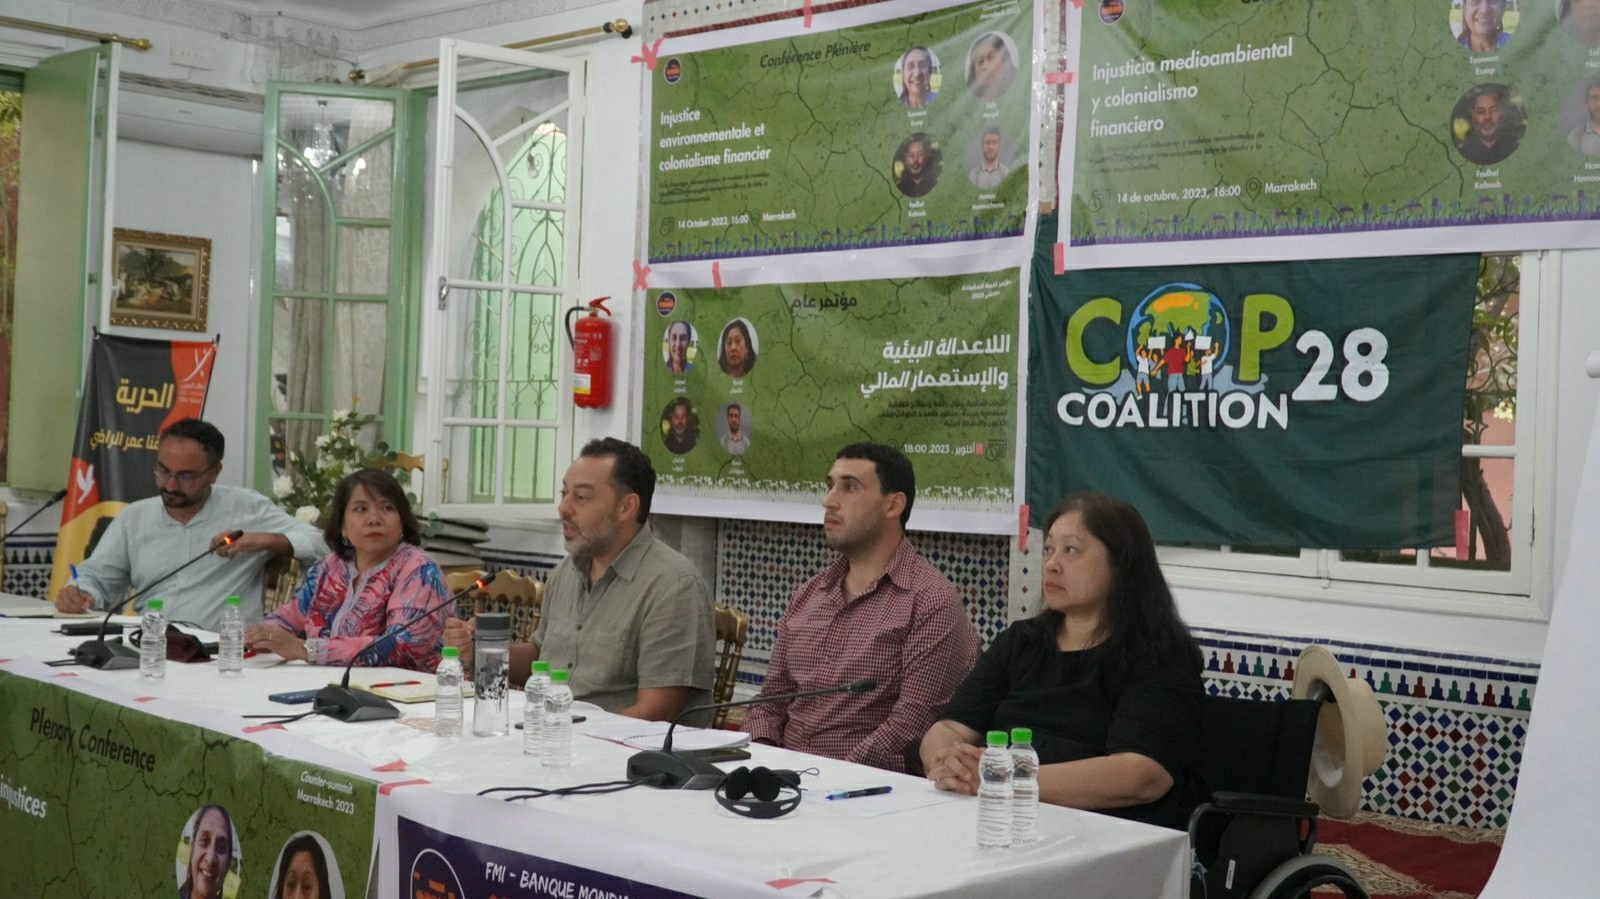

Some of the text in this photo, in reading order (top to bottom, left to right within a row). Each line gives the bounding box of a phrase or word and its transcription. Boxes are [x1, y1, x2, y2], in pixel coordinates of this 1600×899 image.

[760, 41, 871, 68] Conférence Plénière
[1092, 36, 1293, 84] Injusticia medioambiental
[1091, 84, 1198, 114] y colonialismo
[660, 107, 700, 128] Injustice
[1090, 116, 1164, 137] financiero
[659, 122, 765, 148] environnementale et
[659, 146, 771, 172] colonialisme financier
[1264, 177, 1317, 194] Marrakech
[1474, 180, 1502, 190] Kaboub
[1476, 168, 1499, 178] Fadhel
[1117, 185, 1241, 203] 14 de octubre, 2023, 16:00
[678, 220, 686, 229] 14
[731, 214, 749, 225] 16:00
[763, 209, 796, 222] Marrakech
[790, 291, 858, 315] مؤتمر عام
[882, 334, 1010, 363] اللاعدالة البيئية
[1292, 327, 1390, 402] 28
[860, 366, 1009, 398] والإستعمار المالي
[116, 378, 175, 414] الحرية
[1057, 391, 1289, 430] COALITION
[904, 443, 927, 454] 18:00
[30, 707, 156, 772] Plenary Conference
[301, 770, 353, 794] Counter-summit
[297, 788, 354, 814] Marrakech 2023
[485, 861, 506, 884] FMI
[520, 869, 575, 899] BANQUE
